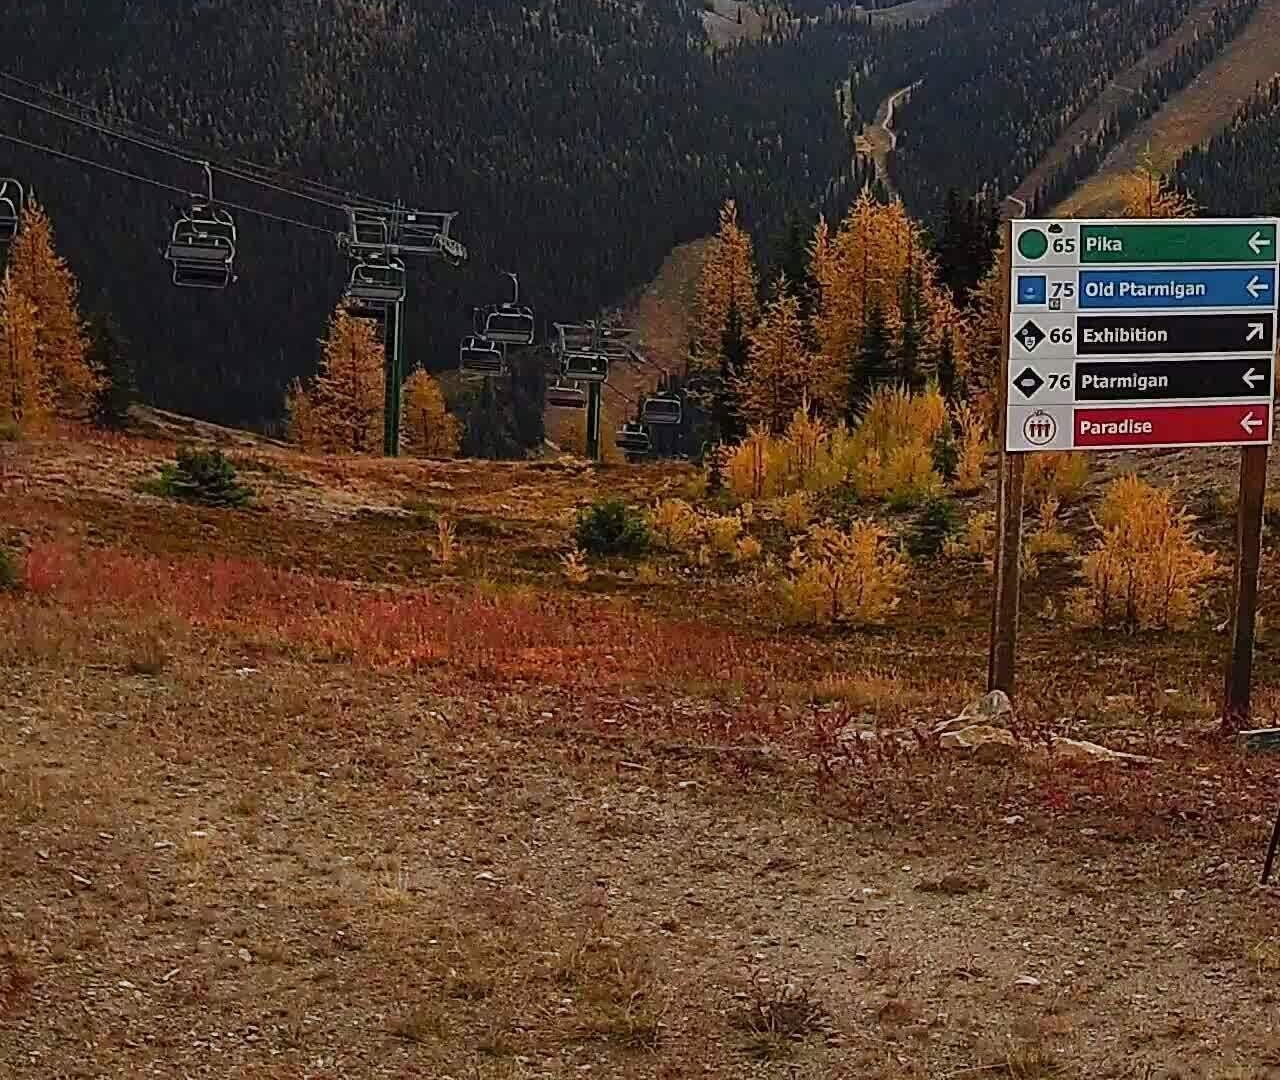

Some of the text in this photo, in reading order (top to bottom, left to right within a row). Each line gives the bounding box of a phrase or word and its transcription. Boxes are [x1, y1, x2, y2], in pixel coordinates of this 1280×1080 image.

[1052, 236, 1123, 253] 65 Pika
[1051, 281, 1206, 300] 75 Old Ptarmigan
[1049, 328, 1168, 344] 66 Exhibition
[1048, 372, 1169, 391] 76 Ptarmigan
[1080, 420, 1153, 436] Paradise
